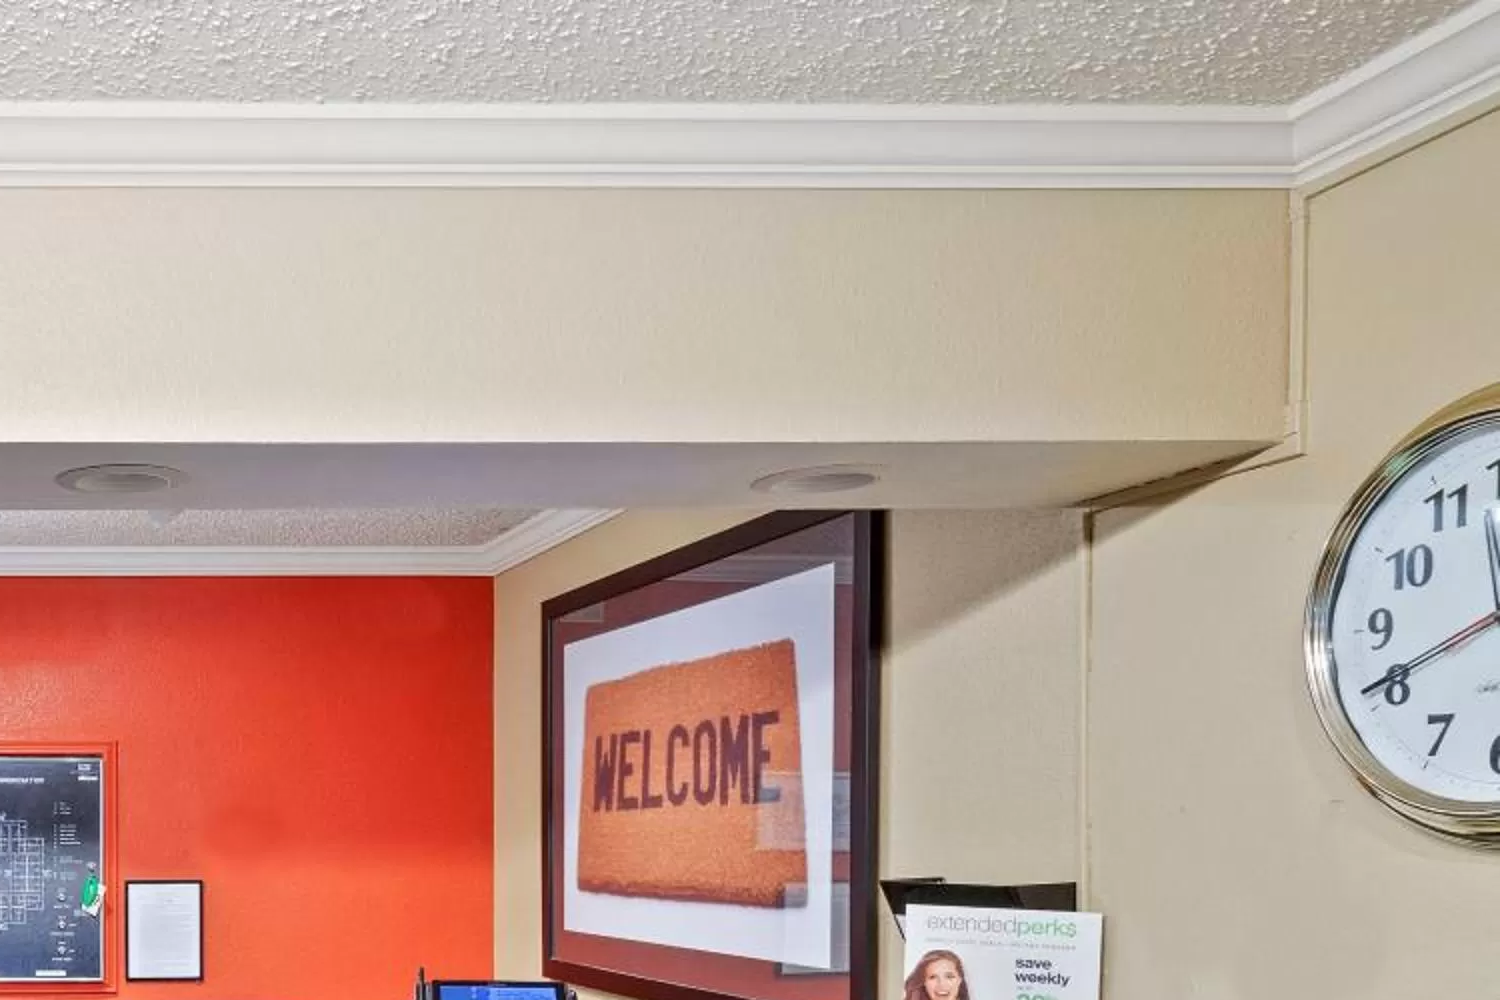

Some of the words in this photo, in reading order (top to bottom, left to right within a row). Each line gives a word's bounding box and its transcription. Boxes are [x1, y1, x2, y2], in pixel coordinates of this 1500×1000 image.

[1423, 484, 1467, 533] 11
[1385, 543, 1433, 591] 10
[1367, 607, 1394, 651] 9
[1383, 663, 1411, 706] 8
[1426, 712, 1455, 757] 7
[594, 710, 781, 812] WELCOME
[927, 914, 1077, 938] extendedperks
[1015, 971, 1071, 988] weekly
[1016, 958, 1052, 970] save
